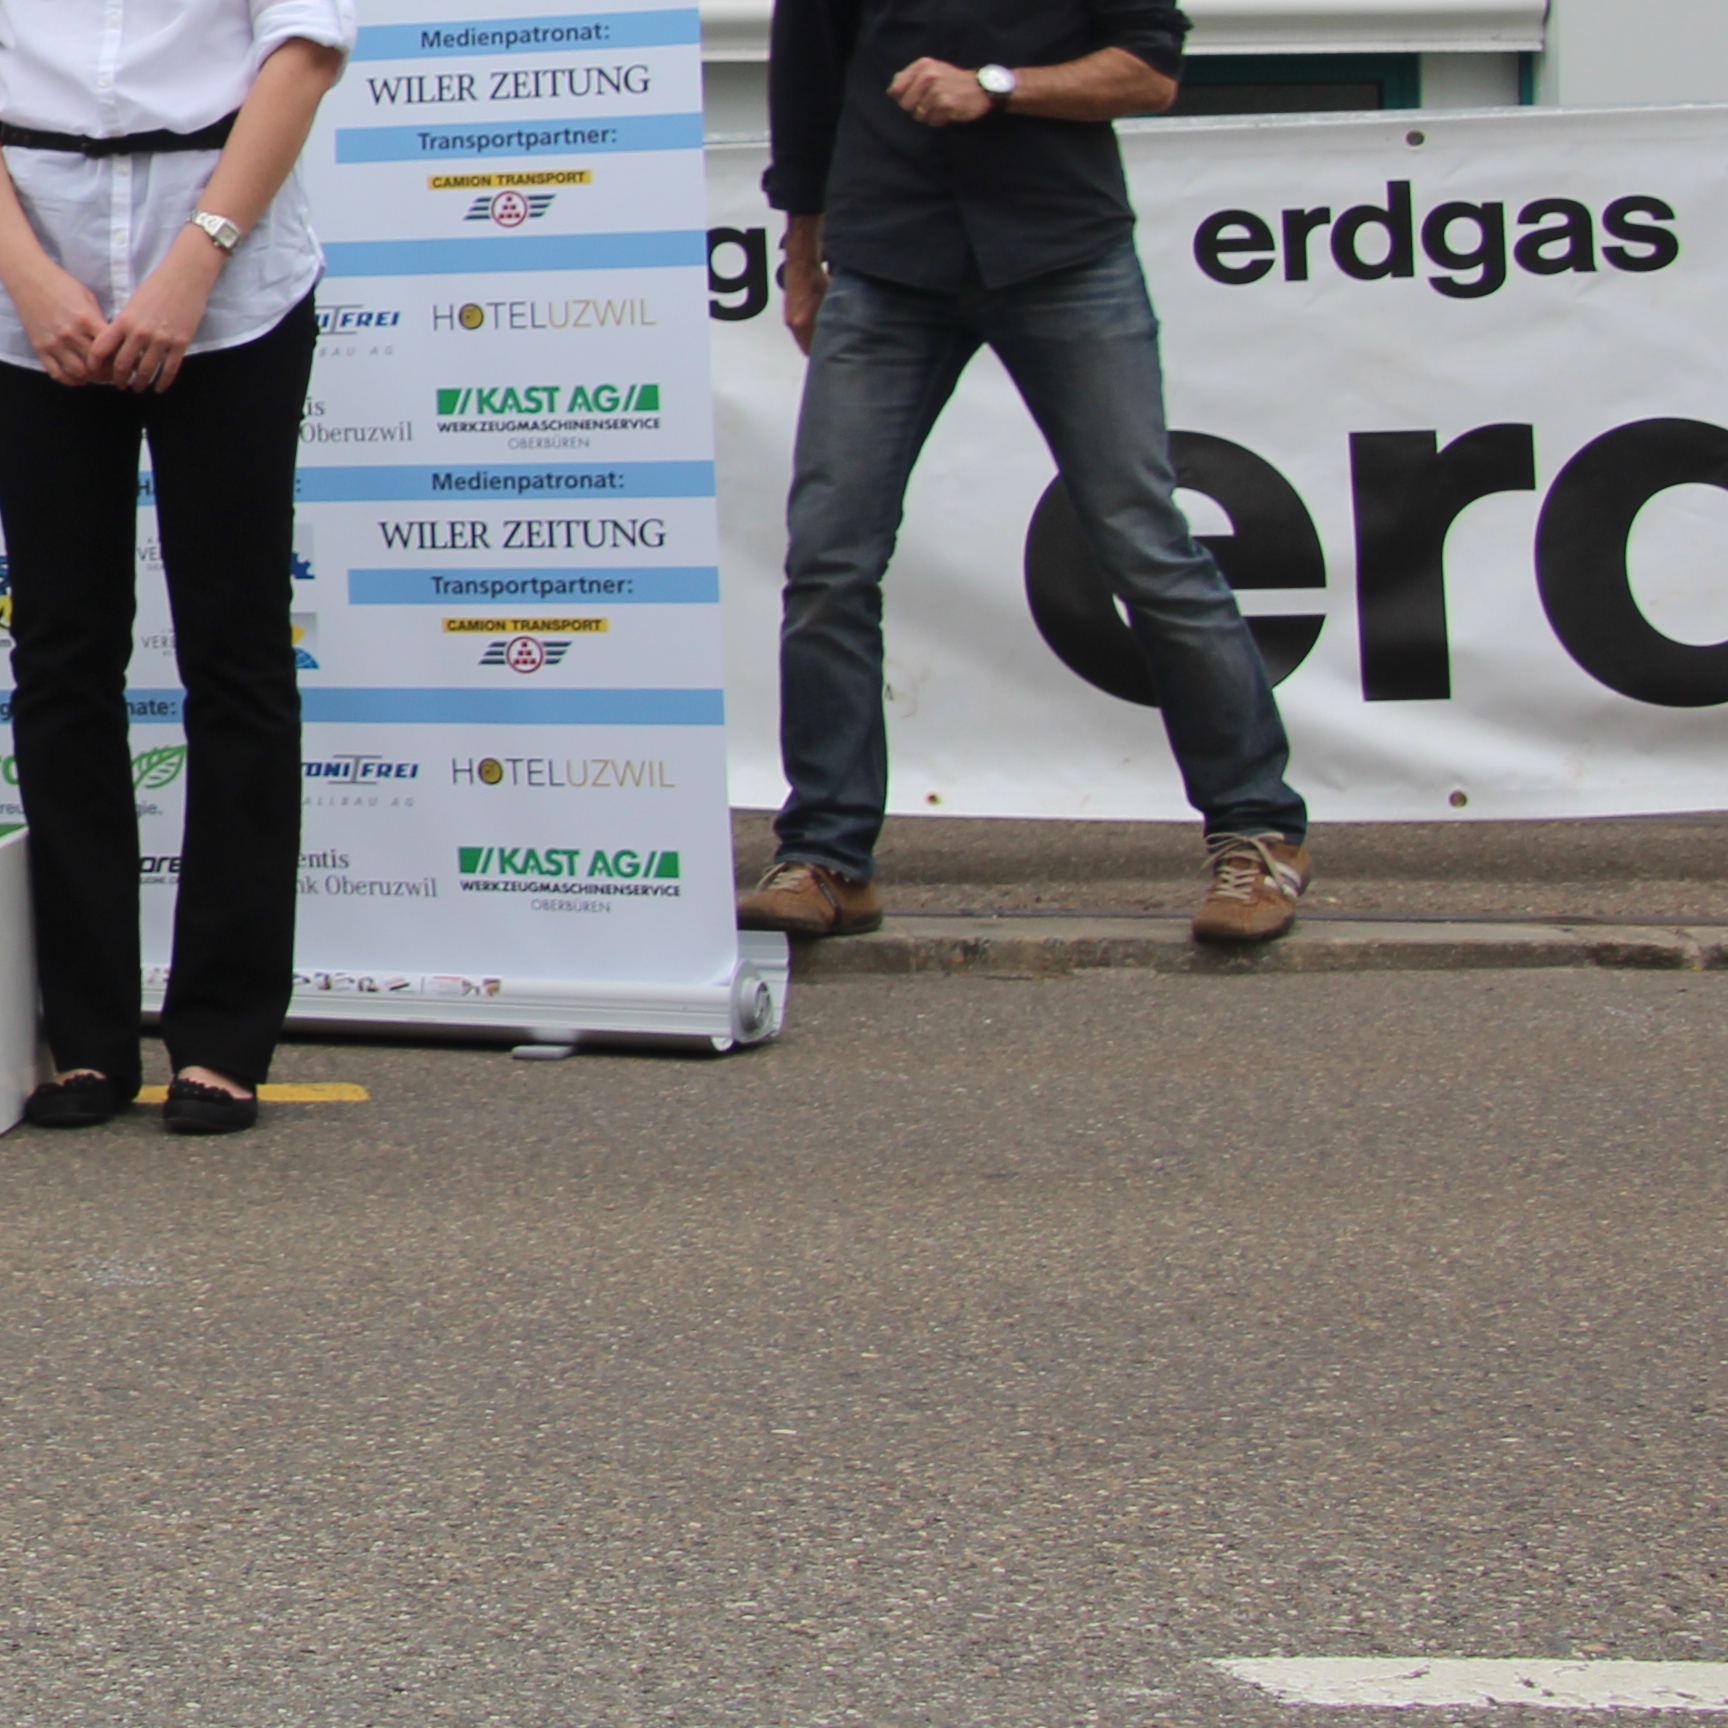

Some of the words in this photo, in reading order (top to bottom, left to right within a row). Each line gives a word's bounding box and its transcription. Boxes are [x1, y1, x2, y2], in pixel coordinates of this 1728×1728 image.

[420, 23, 610, 49] Medienpatronat:
[366, 73, 478, 106] WILER
[488, 64, 652, 101] ZEITUNG
[417, 127, 618, 152] Transportpartner:
[432, 175, 492, 189] CAMION
[496, 171, 585, 186] TRANSPORT
[1193, 179, 1681, 299] erdgas
[340, 310, 401, 328] FREI
[476, 385, 561, 414] KAST
[567, 384, 621, 413] AG
[300, 421, 413, 444] Oberuzwil
[437, 418, 661, 433] WERKZEUGMASCHINENSERVICE
[507, 435, 590, 451] OBERBÜREN
[431, 472, 625, 494] Medienpatronat:
[378, 521, 491, 550] WILER
[502, 519, 667, 549] ZEITUNG
[431, 575, 634, 598] Transportpartner:
[446, 619, 506, 632] CAMION
[512, 618, 602, 632] TRANSPORT
[360, 762, 419, 779] FREI
[498, 847, 580, 877] KAST
[587, 849, 641, 879] AG
[325, 874, 438, 898] Oberuzwil
[460, 880, 681, 897] WERKZEUGMASCHINENSERVICE
[530, 898, 611, 914] OBERBÜREN
